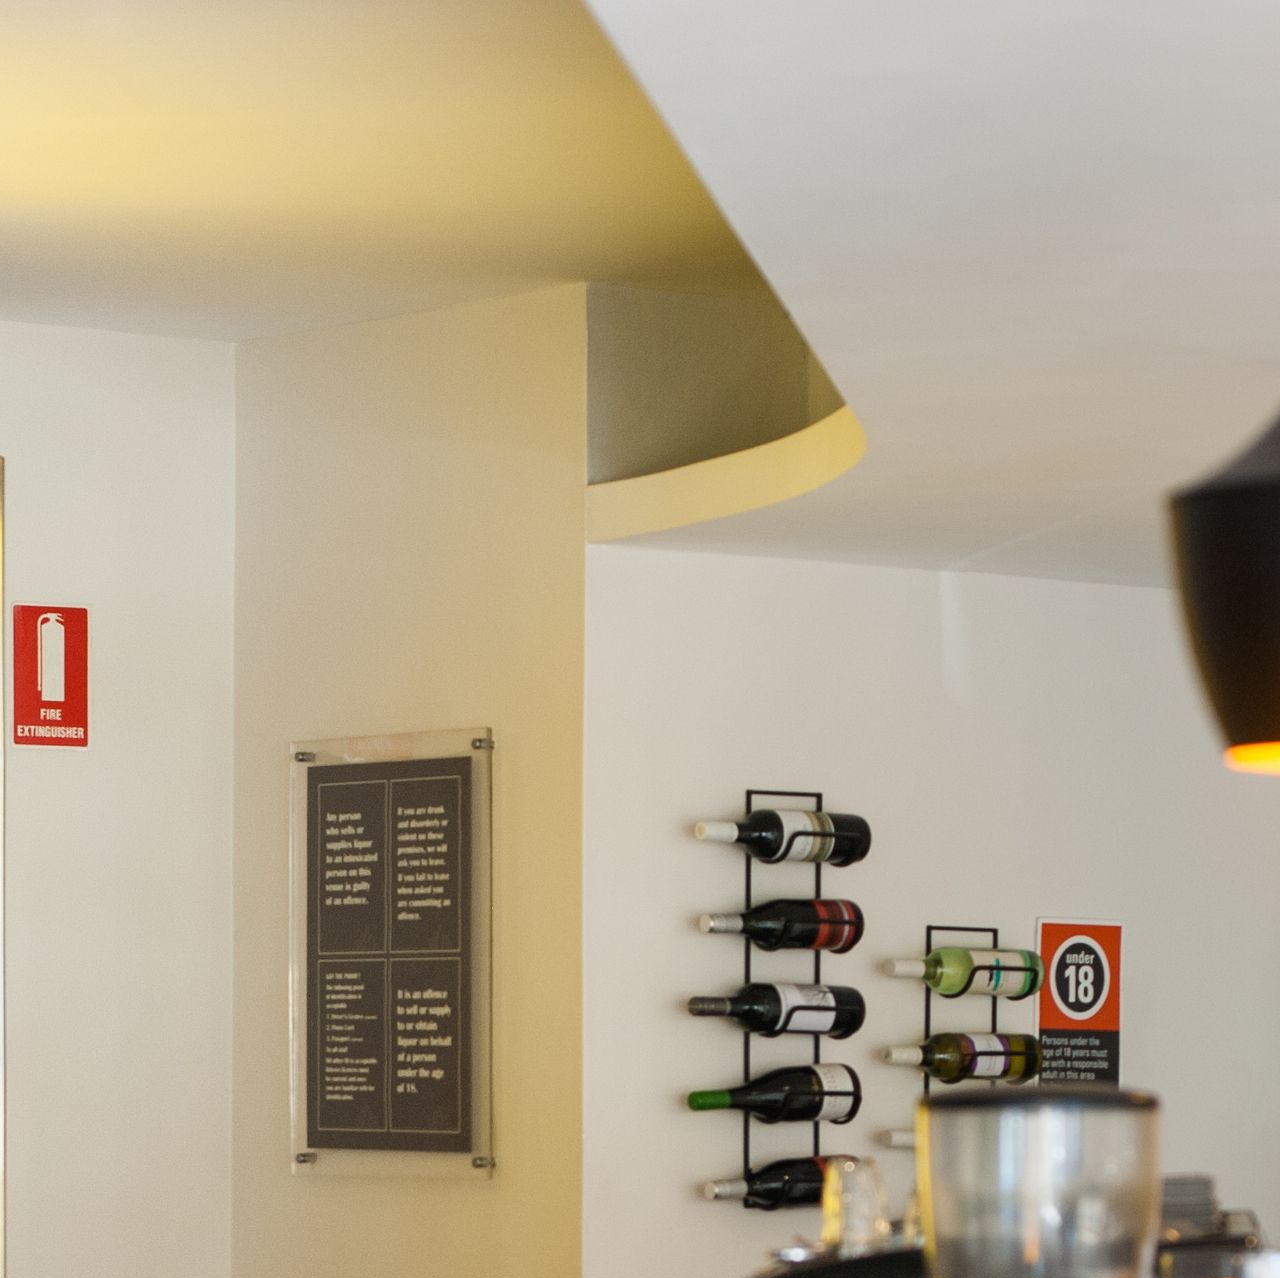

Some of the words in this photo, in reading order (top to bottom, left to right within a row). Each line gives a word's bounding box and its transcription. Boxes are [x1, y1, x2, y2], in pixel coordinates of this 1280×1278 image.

[40, 708, 62, 720] FIRE
[17, 725, 84, 739] EXTINGUISHER
[339, 813, 361, 822] person
[1066, 951, 1095, 964] under
[1064, 965, 1094, 1004] 18
[1042, 1035, 1068, 1046] Persons
[1069, 1036, 1088, 1046] under
[1089, 1036, 1100, 1046] the
[412, 1053, 437, 1063] person
[1055, 1048, 1062, 1056] of
[1072, 1049, 1090, 1059] years
[1090, 1049, 1108, 1057] must
[1051, 1059, 1066, 1068] with
[1072, 1060, 1109, 1070] responsible
[1041, 1071, 1057, 1079] adult
[1059, 1071, 1065, 1079] in
[1066, 1070, 1078, 1079] this
[1080, 1072, 1096, 1081] area
